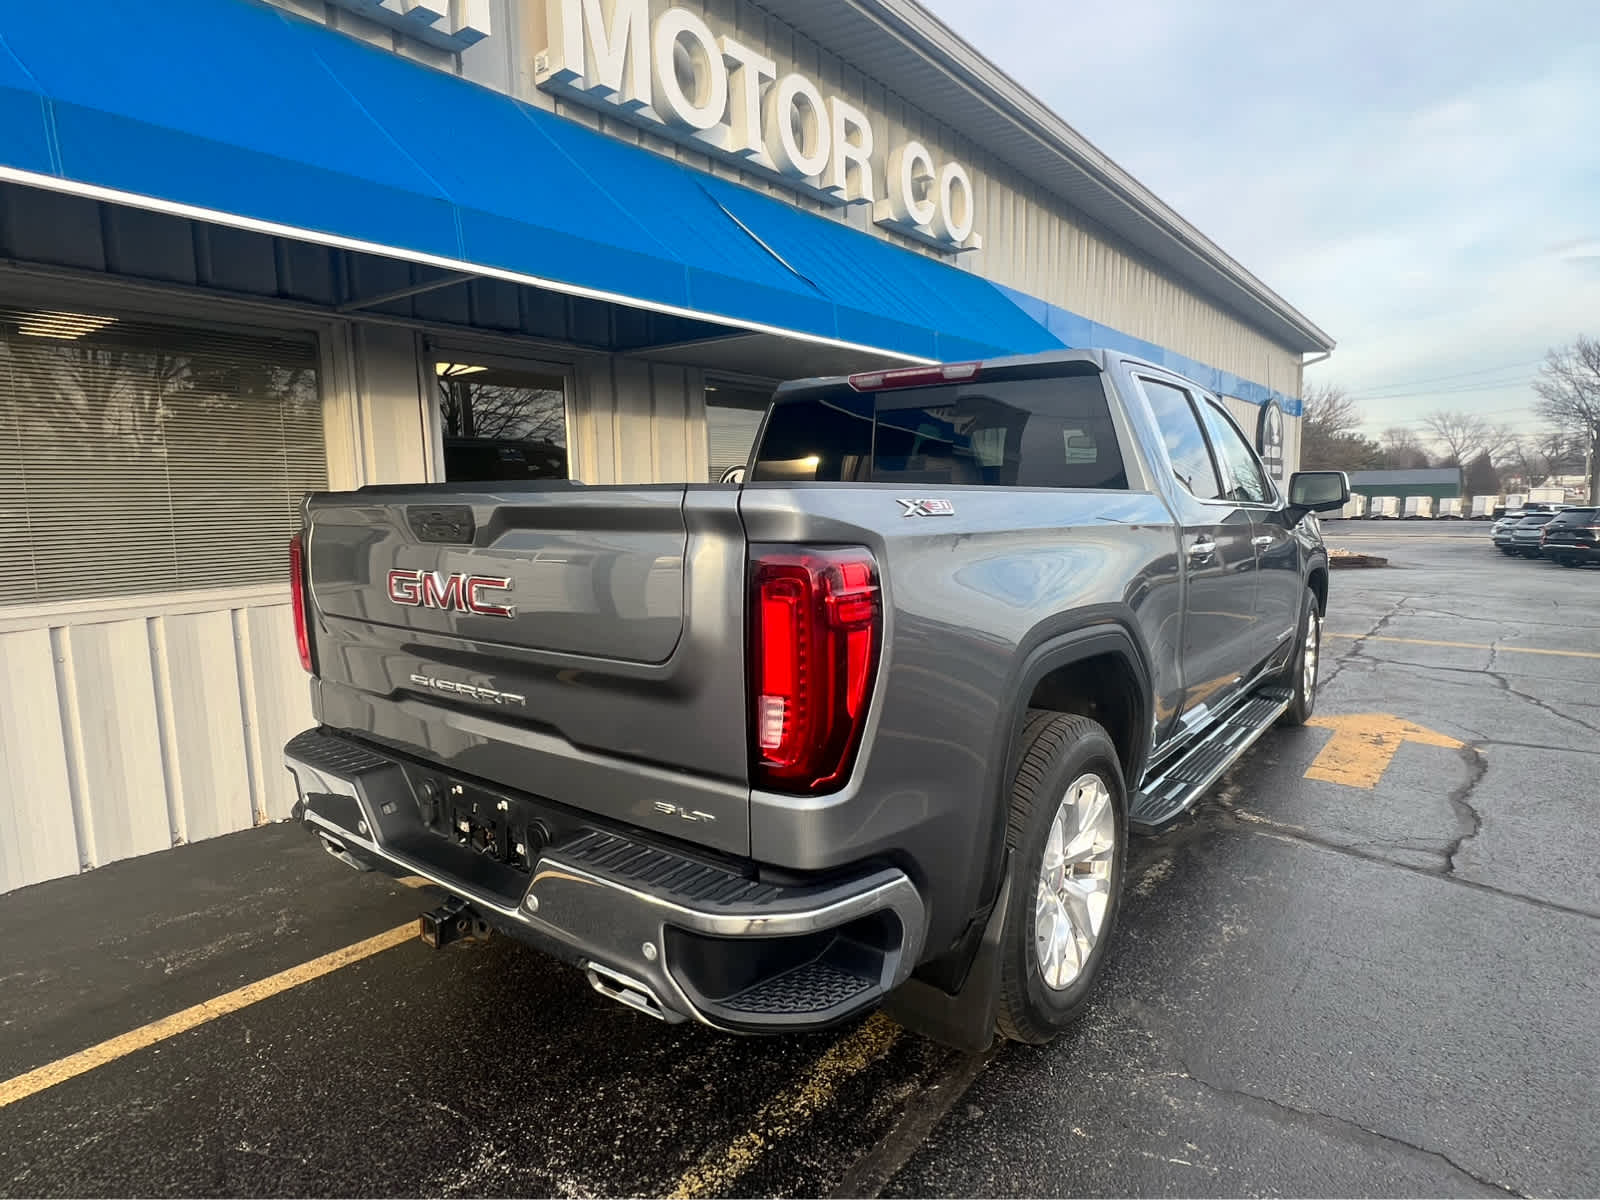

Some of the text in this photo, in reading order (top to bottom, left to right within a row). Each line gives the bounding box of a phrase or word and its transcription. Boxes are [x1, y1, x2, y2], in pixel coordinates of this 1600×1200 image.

[548, 0, 874, 205] MOTOR
[387, 567, 515, 618] GMC
[410, 674, 526, 706] SIERRA
[654, 801, 716, 823] SLT
